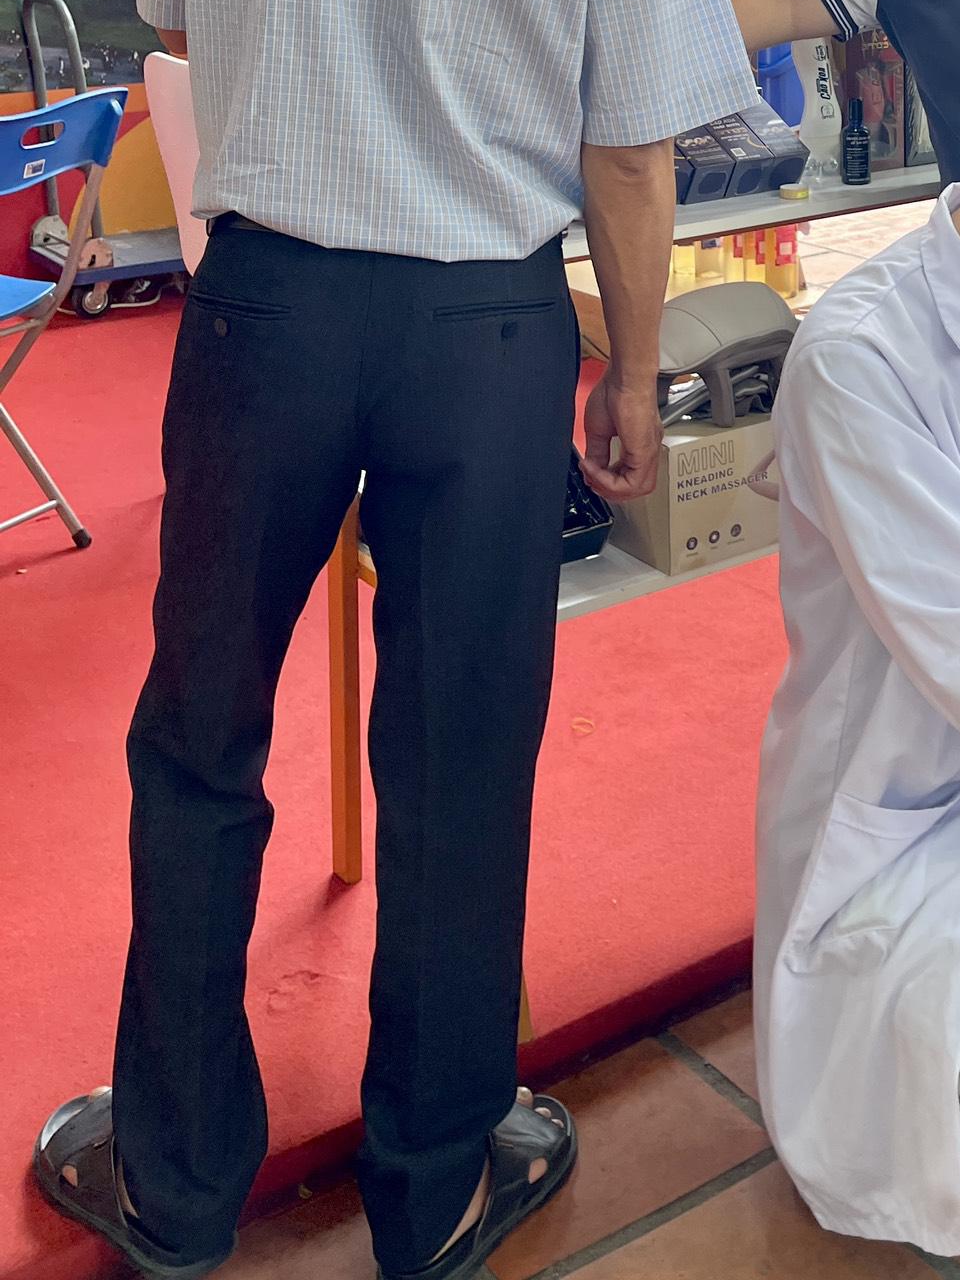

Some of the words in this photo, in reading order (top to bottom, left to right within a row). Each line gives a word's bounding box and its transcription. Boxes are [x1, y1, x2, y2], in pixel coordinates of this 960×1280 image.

[677, 439, 735, 478] MINI
[677, 467, 735, 490] KNEADING
[677, 487, 708, 503] NECK
[711, 471, 768, 495] MASSAGER
